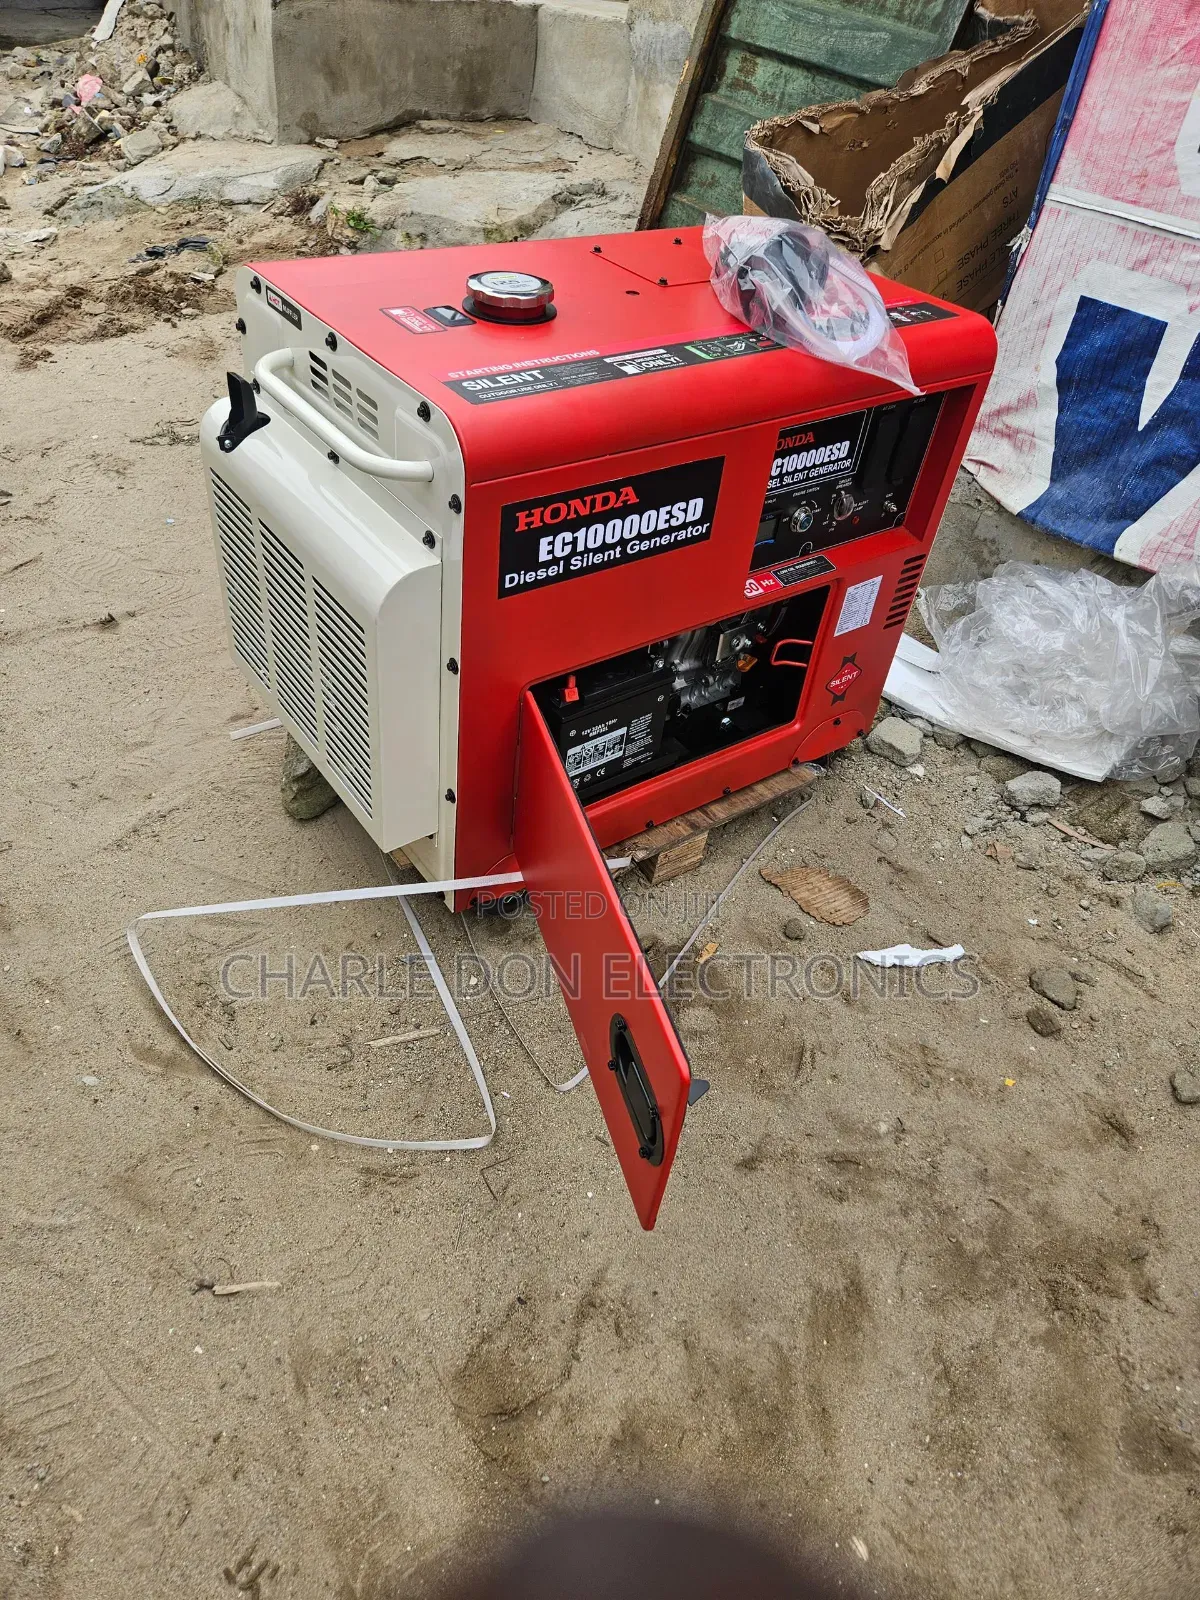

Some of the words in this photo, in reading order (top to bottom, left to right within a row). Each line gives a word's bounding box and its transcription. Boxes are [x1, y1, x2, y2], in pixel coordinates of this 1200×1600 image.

[1002, 186, 1018, 208] ATS
[990, 210, 1020, 242] THREE
[956, 236, 990, 270] PHASE
[955, 258, 989, 293] PHASE
[448, 364, 514, 379] STARTING
[513, 349, 601, 370] INSTRUCTIONS
[642, 356, 683, 369] ONLY!
[461, 369, 546, 391] SILENT
[776, 431, 815, 451] ONDA
[770, 440, 851, 477] C10000ESD
[782, 470, 809, 485] SILENT
[808, 458, 852, 477] GENERATOR
[515, 486, 639, 532] HONDA
[538, 497, 704, 562] EC10000ESD
[504, 560, 564, 589] Diesel
[569, 547, 622, 571] Silent
[626, 521, 711, 555] Generator
[760, 579, 776, 587] Hz
[830, 670, 859, 688] SILENT
